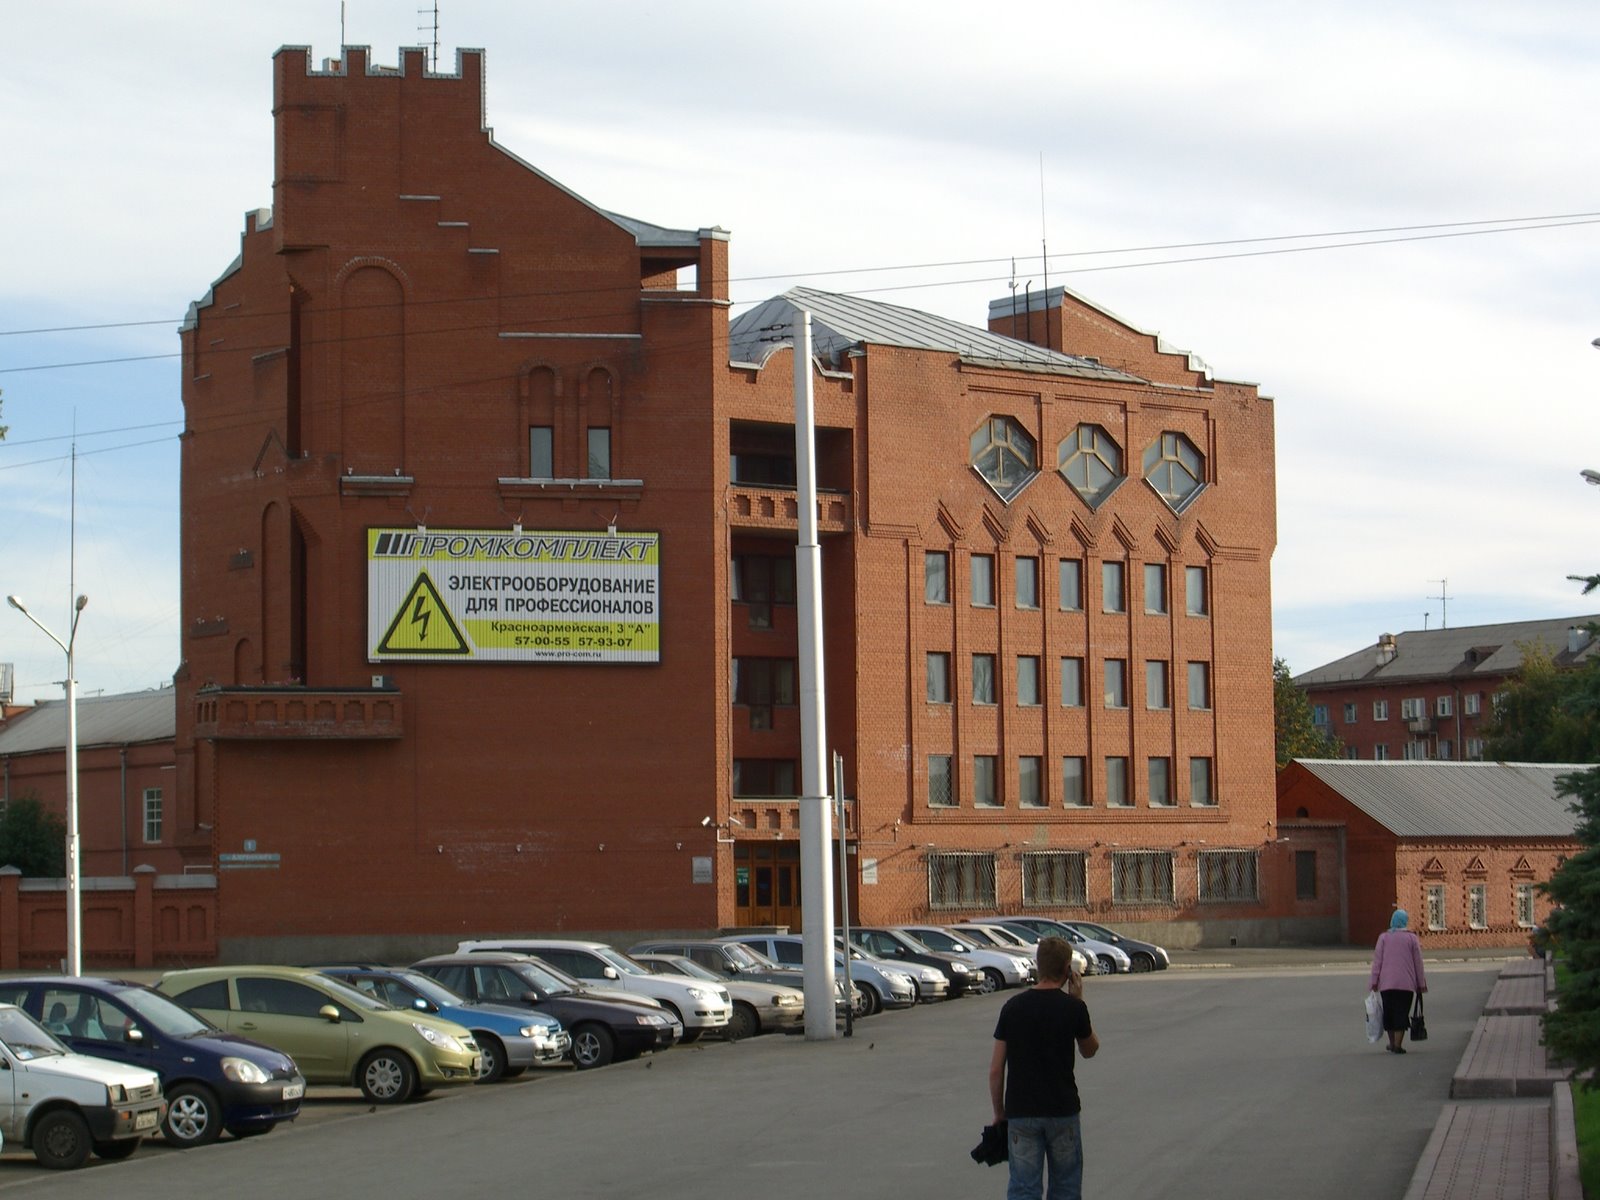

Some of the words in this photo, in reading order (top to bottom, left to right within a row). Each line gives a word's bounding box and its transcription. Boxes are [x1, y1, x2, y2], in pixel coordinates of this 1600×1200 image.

[406, 535, 655, 560] ПРОМКОМПЛЕКТ
[448, 575, 656, 595] ЭЛЕКТРООБОРУДОВАНИЕ
[465, 597, 498, 614] ДЛЯ
[505, 598, 654, 615] ПРОФЕССИОНАЛОВ
[491, 621, 613, 635] Красноармейская,
[616, 623, 625, 634] 3
[514, 636, 571, 646] 57-00-55
[578, 637, 633, 647] 57-93-07
[534, 650, 602, 658] www.pro-com.ru
